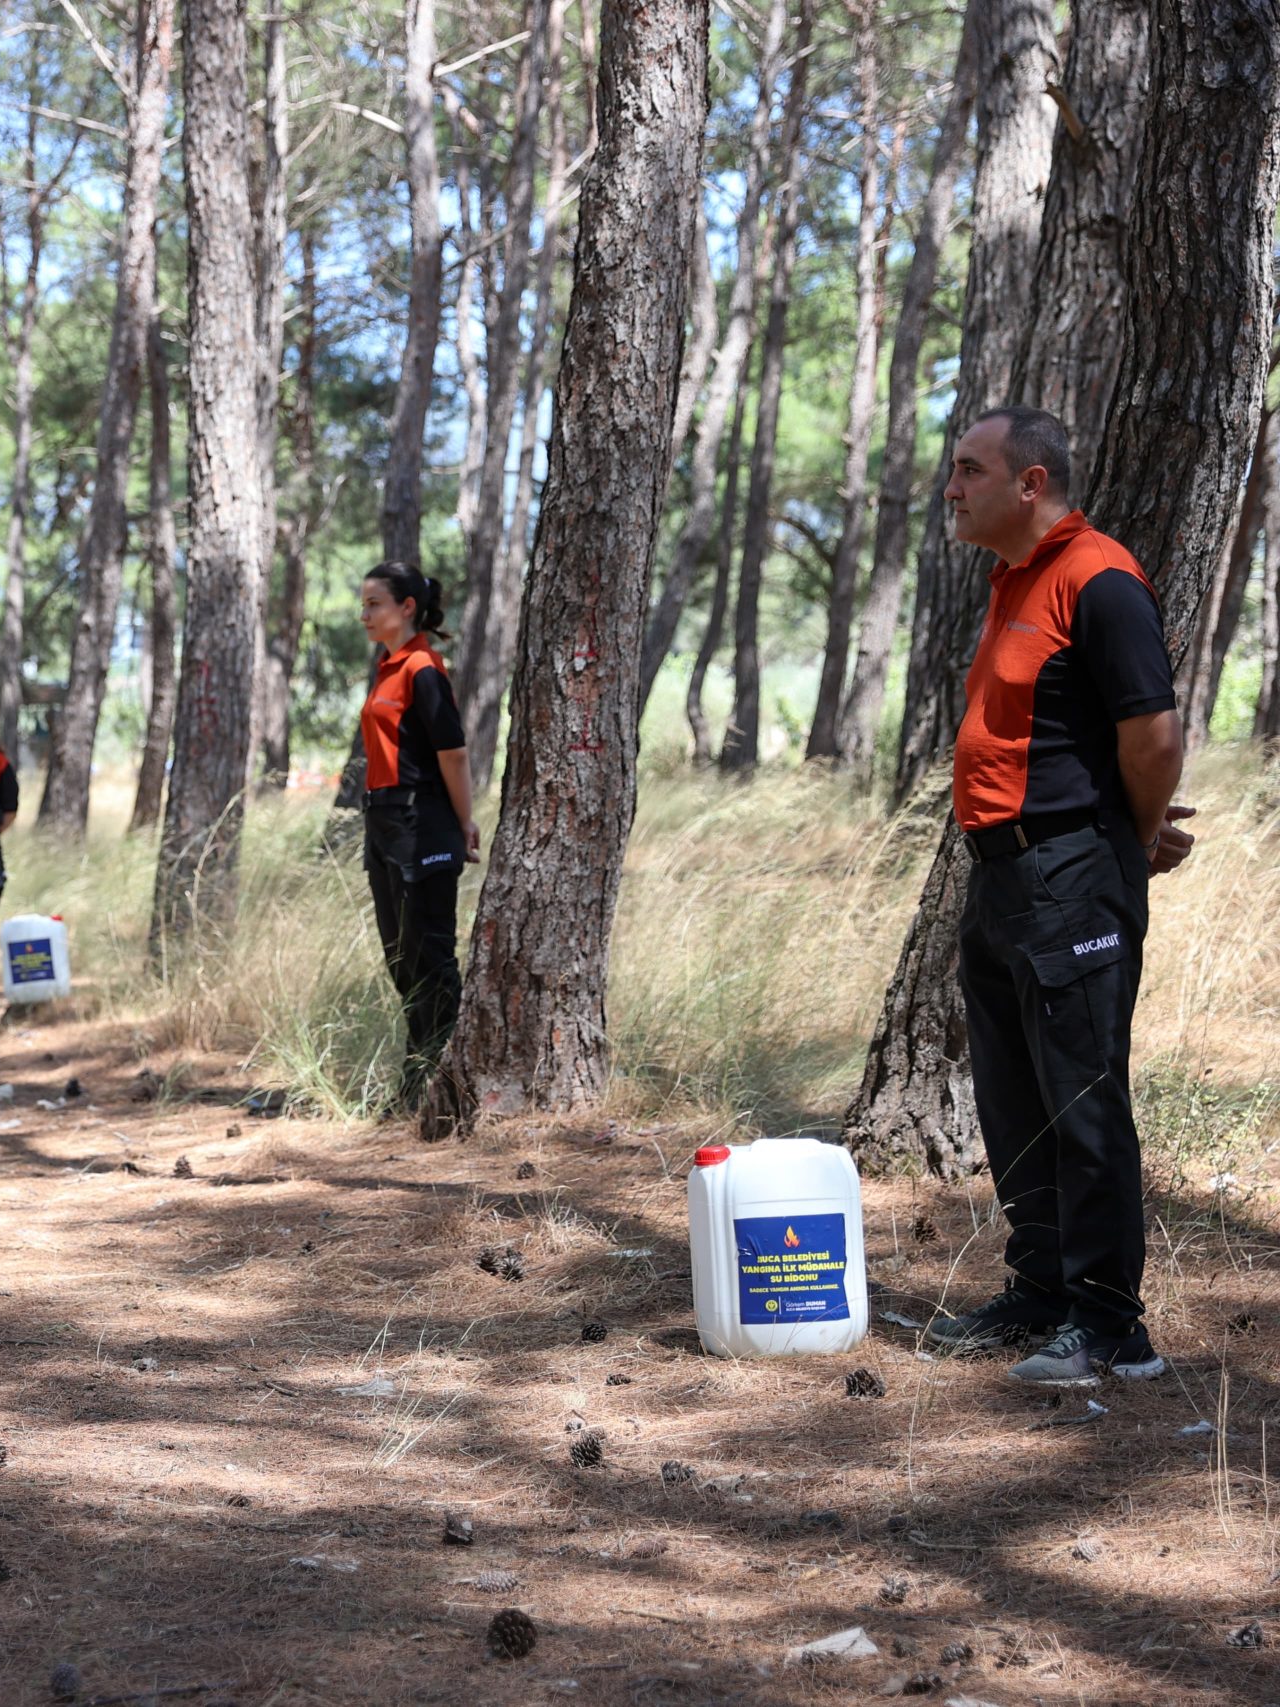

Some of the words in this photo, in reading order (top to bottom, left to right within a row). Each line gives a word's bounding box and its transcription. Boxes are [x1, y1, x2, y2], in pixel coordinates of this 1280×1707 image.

[1072, 933, 1120, 956] BUCAKUT
[782, 1250, 829, 1262] BELEDİYESİ
[741, 1265, 782, 1274] YANGINA
[782, 1263, 797, 1273] İLK
[797, 1261, 845, 1272] MÜDAHALE
[770, 1274, 783, 1283] SU
[783, 1272, 819, 1282] BİDONU
